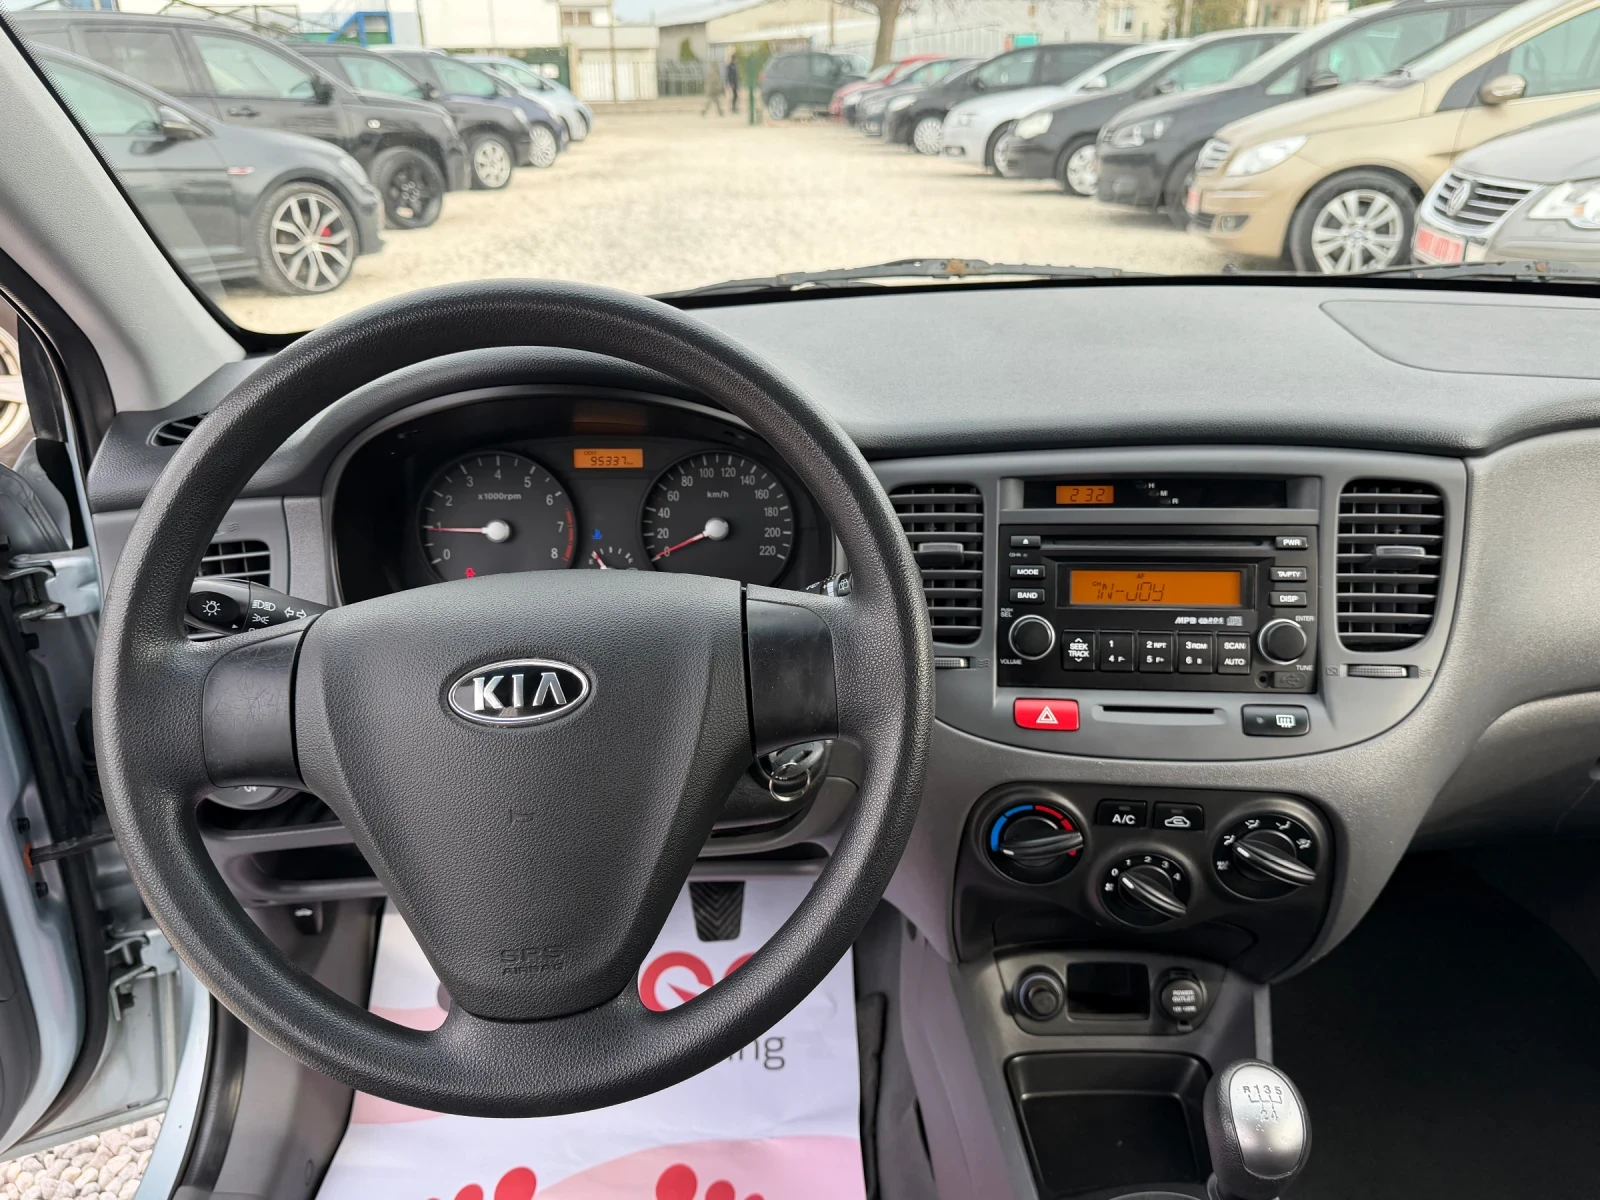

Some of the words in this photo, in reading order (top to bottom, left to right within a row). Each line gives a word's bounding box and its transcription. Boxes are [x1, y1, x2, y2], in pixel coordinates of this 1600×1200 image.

[590, 456, 627, 466] 95337
[494, 469, 502, 480] 4
[700, 468, 715, 478] 100
[721, 467, 736, 478] 120
[466, 476, 474, 487] 3
[524, 476, 532, 488] 5
[681, 475, 693, 487] 80
[740, 475, 755, 486] 140
[477, 492, 522, 502] x1000rpm
[546, 494, 553, 506] 6
[667, 490, 680, 501] 60
[706, 491, 730, 499] km/h
[754, 489, 769, 500] 160
[445, 495, 453, 507] 2
[657, 507, 671, 518] 40
[764, 506, 779, 517] 180
[557, 521, 564, 533] 7
[764, 527, 781, 538] 200
[657, 527, 670, 539] 20
[443, 549, 451, 560] 0
[551, 547, 559, 560] 8
[663, 546, 671, 557] 0
[759, 545, 776, 556] 220
[1109, 640, 1114, 648] 1
[1146, 641, 1153, 649] 2
[1186, 641, 1193, 649] 3
[1223, 642, 1247, 650] SCAN
[1068, 650, 1090, 658] TRACK
[1108, 655, 1115, 663] 4
[1146, 655, 1153, 664] 5
[1186, 656, 1193, 664] 6
[1223, 658, 1247, 666] AUTO
[474, 672, 567, 712] KIA
[1111, 813, 1136, 825] A/C
[1125, 858, 1132, 866] 1
[1144, 855, 1153, 863] 2
[1161, 860, 1170, 869] 3
[1111, 868, 1119, 877] 0
[1172, 872, 1181, 881] 4
[1242, 1085, 1252, 1094] R
[1253, 1084, 1260, 1094] 1
[1263, 1085, 1272, 1095] 3
[1274, 1085, 1283, 1096] 5
[1260, 1110, 1269, 1120] 2
[1271, 1110, 1279, 1121] 4
